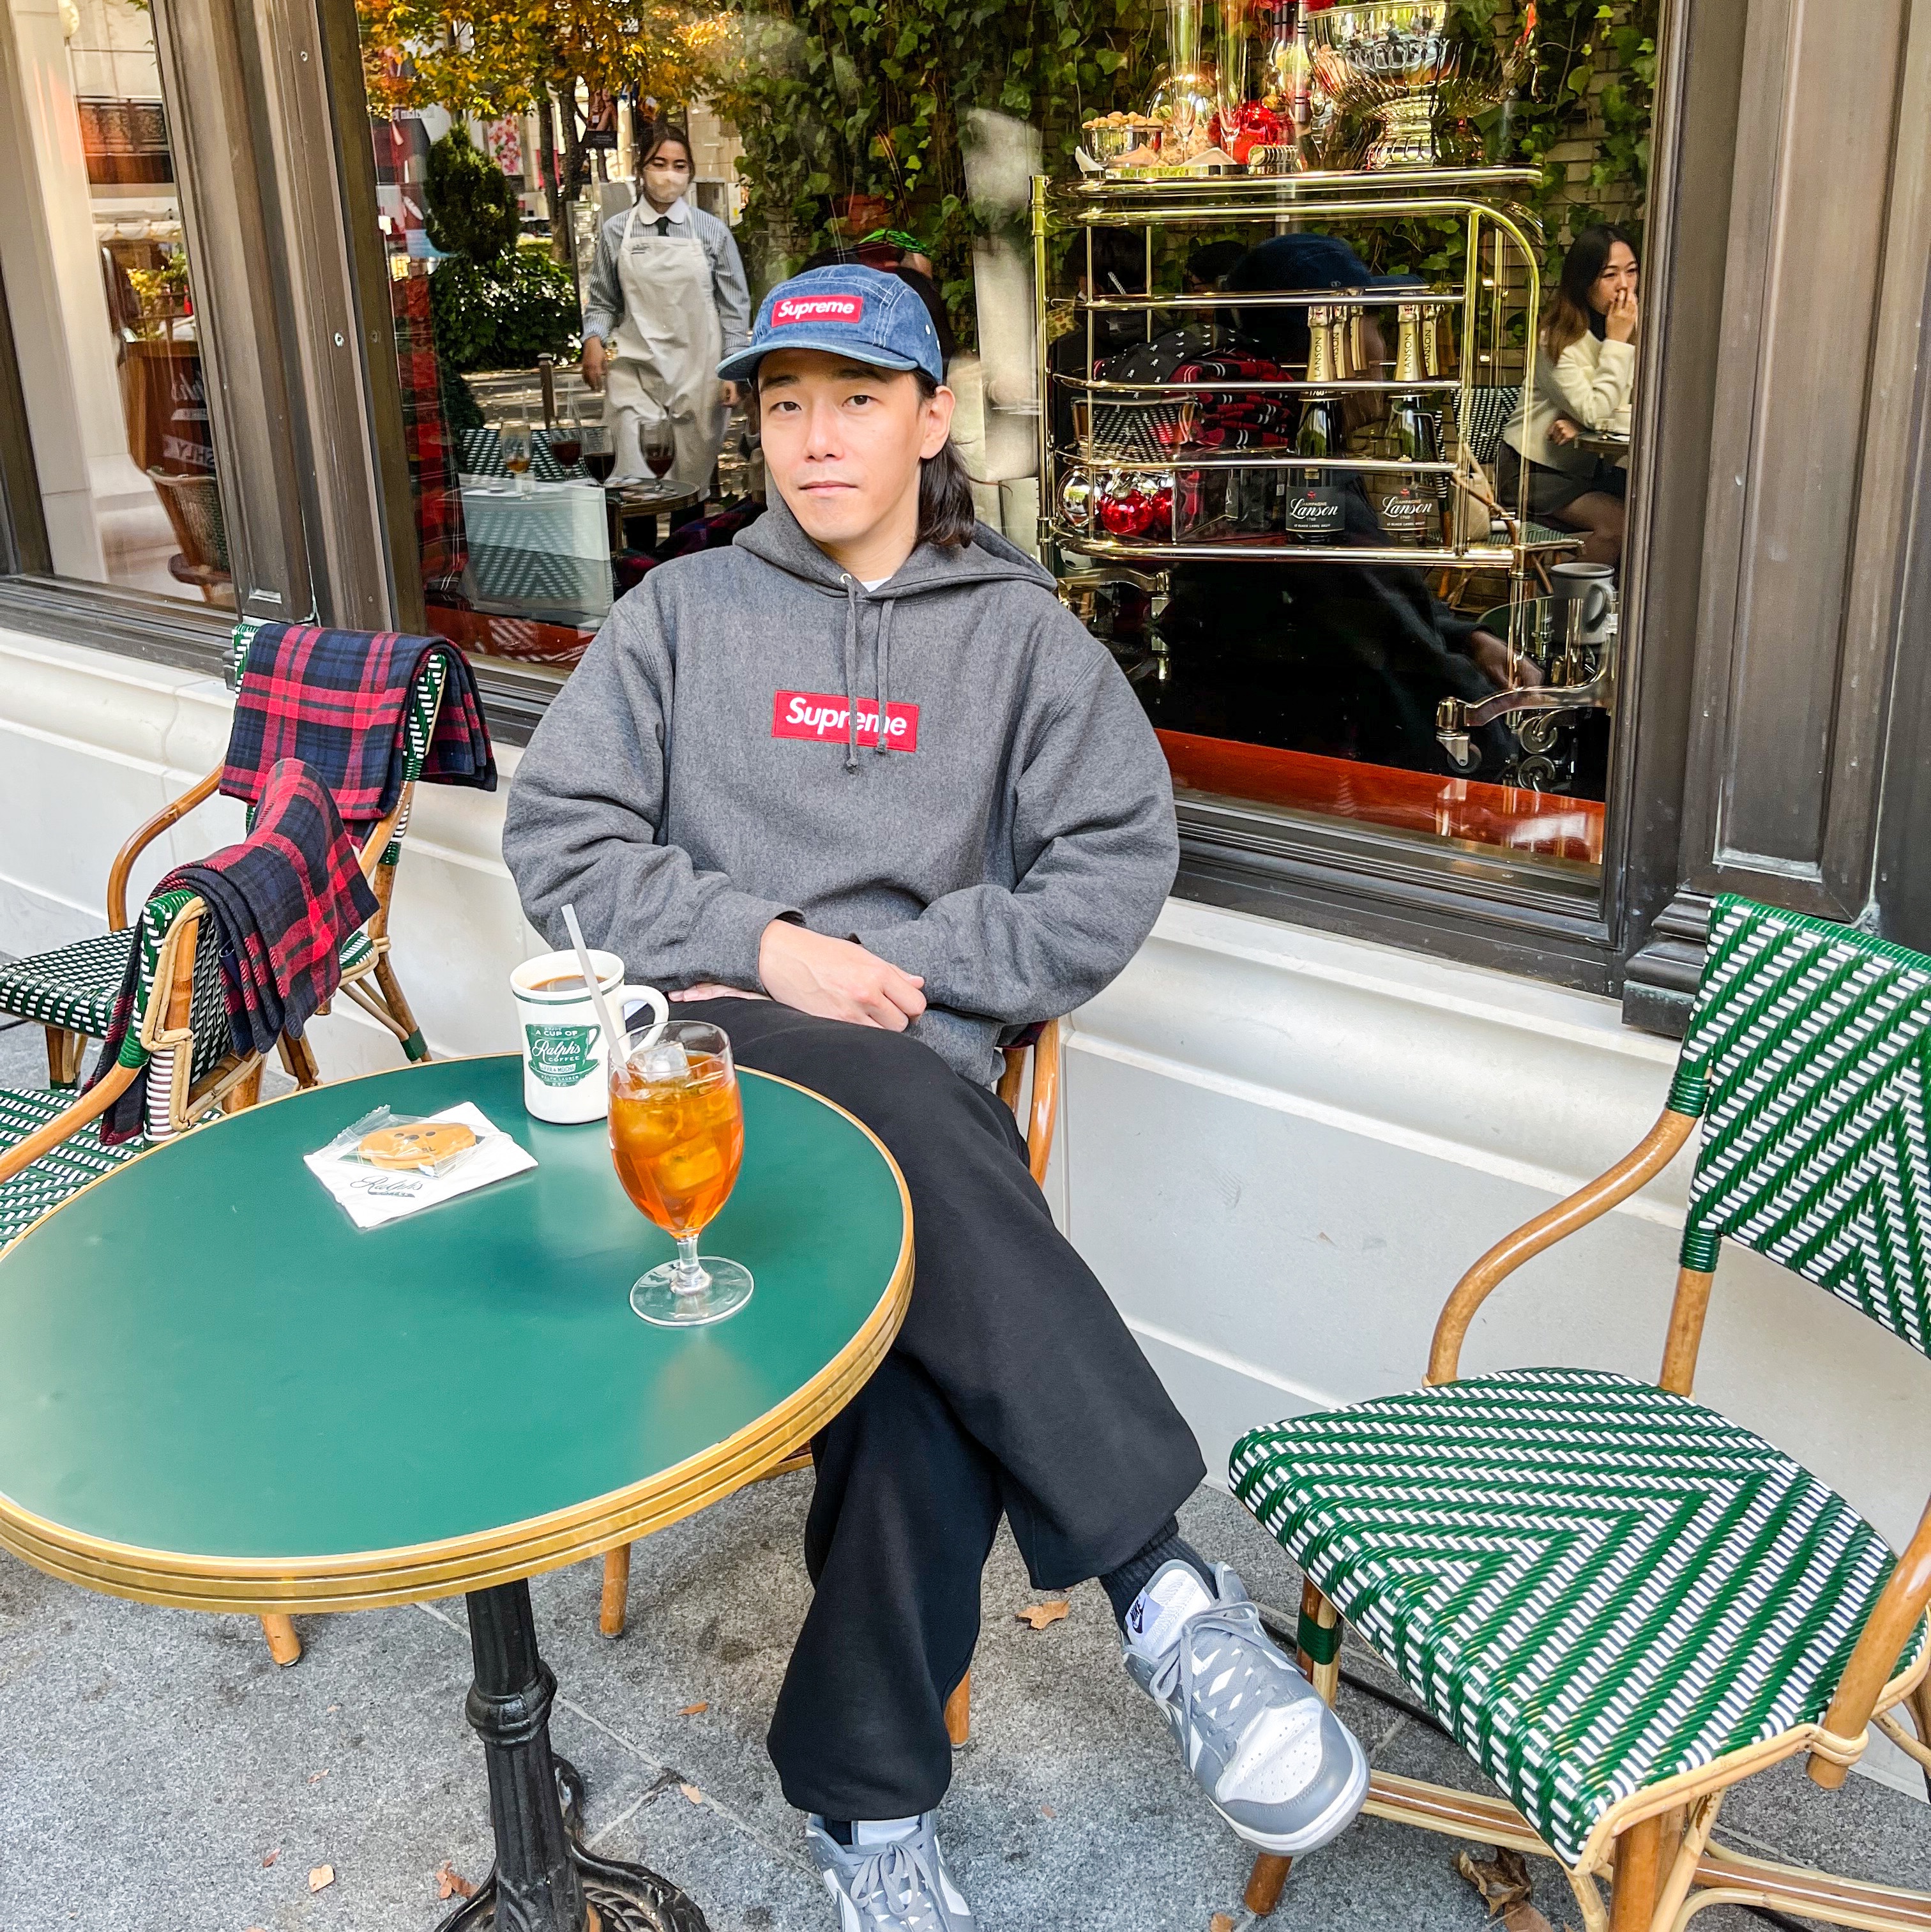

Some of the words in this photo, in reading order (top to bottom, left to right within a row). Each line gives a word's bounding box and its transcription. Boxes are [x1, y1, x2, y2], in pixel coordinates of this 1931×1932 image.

[778, 301, 854, 319] Supreme
[1289, 498, 1338, 519] Lanson
[1381, 496, 1432, 518] Lanson
[785, 697, 907, 736] Supreme
[532, 1038, 580, 1064] Ralph's
[1130, 1599, 1141, 1622] NIKE
